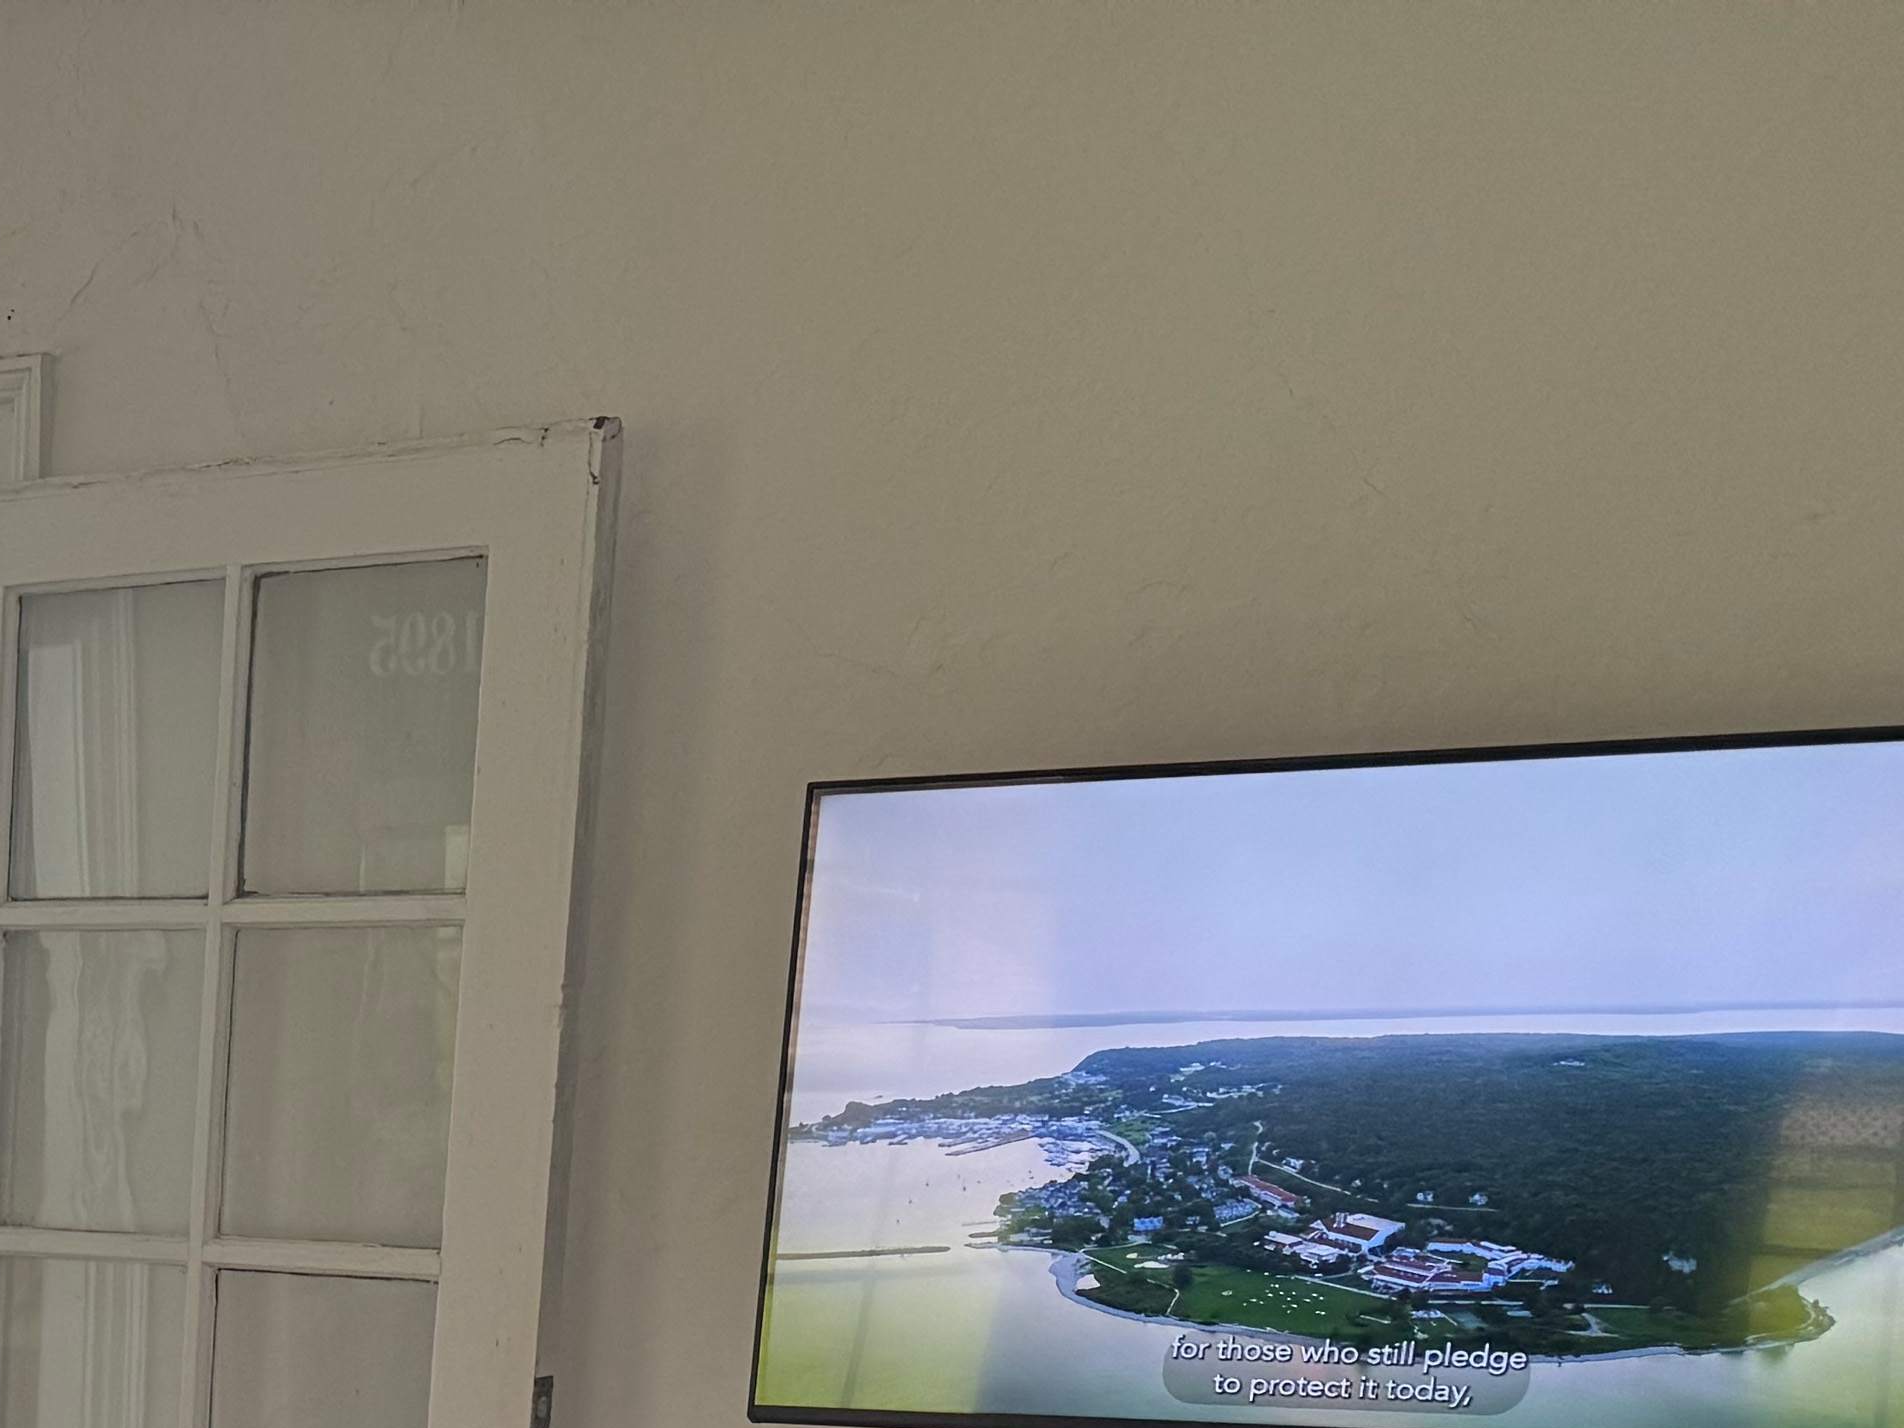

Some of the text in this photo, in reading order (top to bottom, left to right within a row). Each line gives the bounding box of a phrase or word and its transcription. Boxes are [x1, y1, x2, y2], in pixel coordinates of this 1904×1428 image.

[1171, 1335, 1528, 1376] for those who still pledge
[1212, 1373, 1473, 1407] to protect it today,
